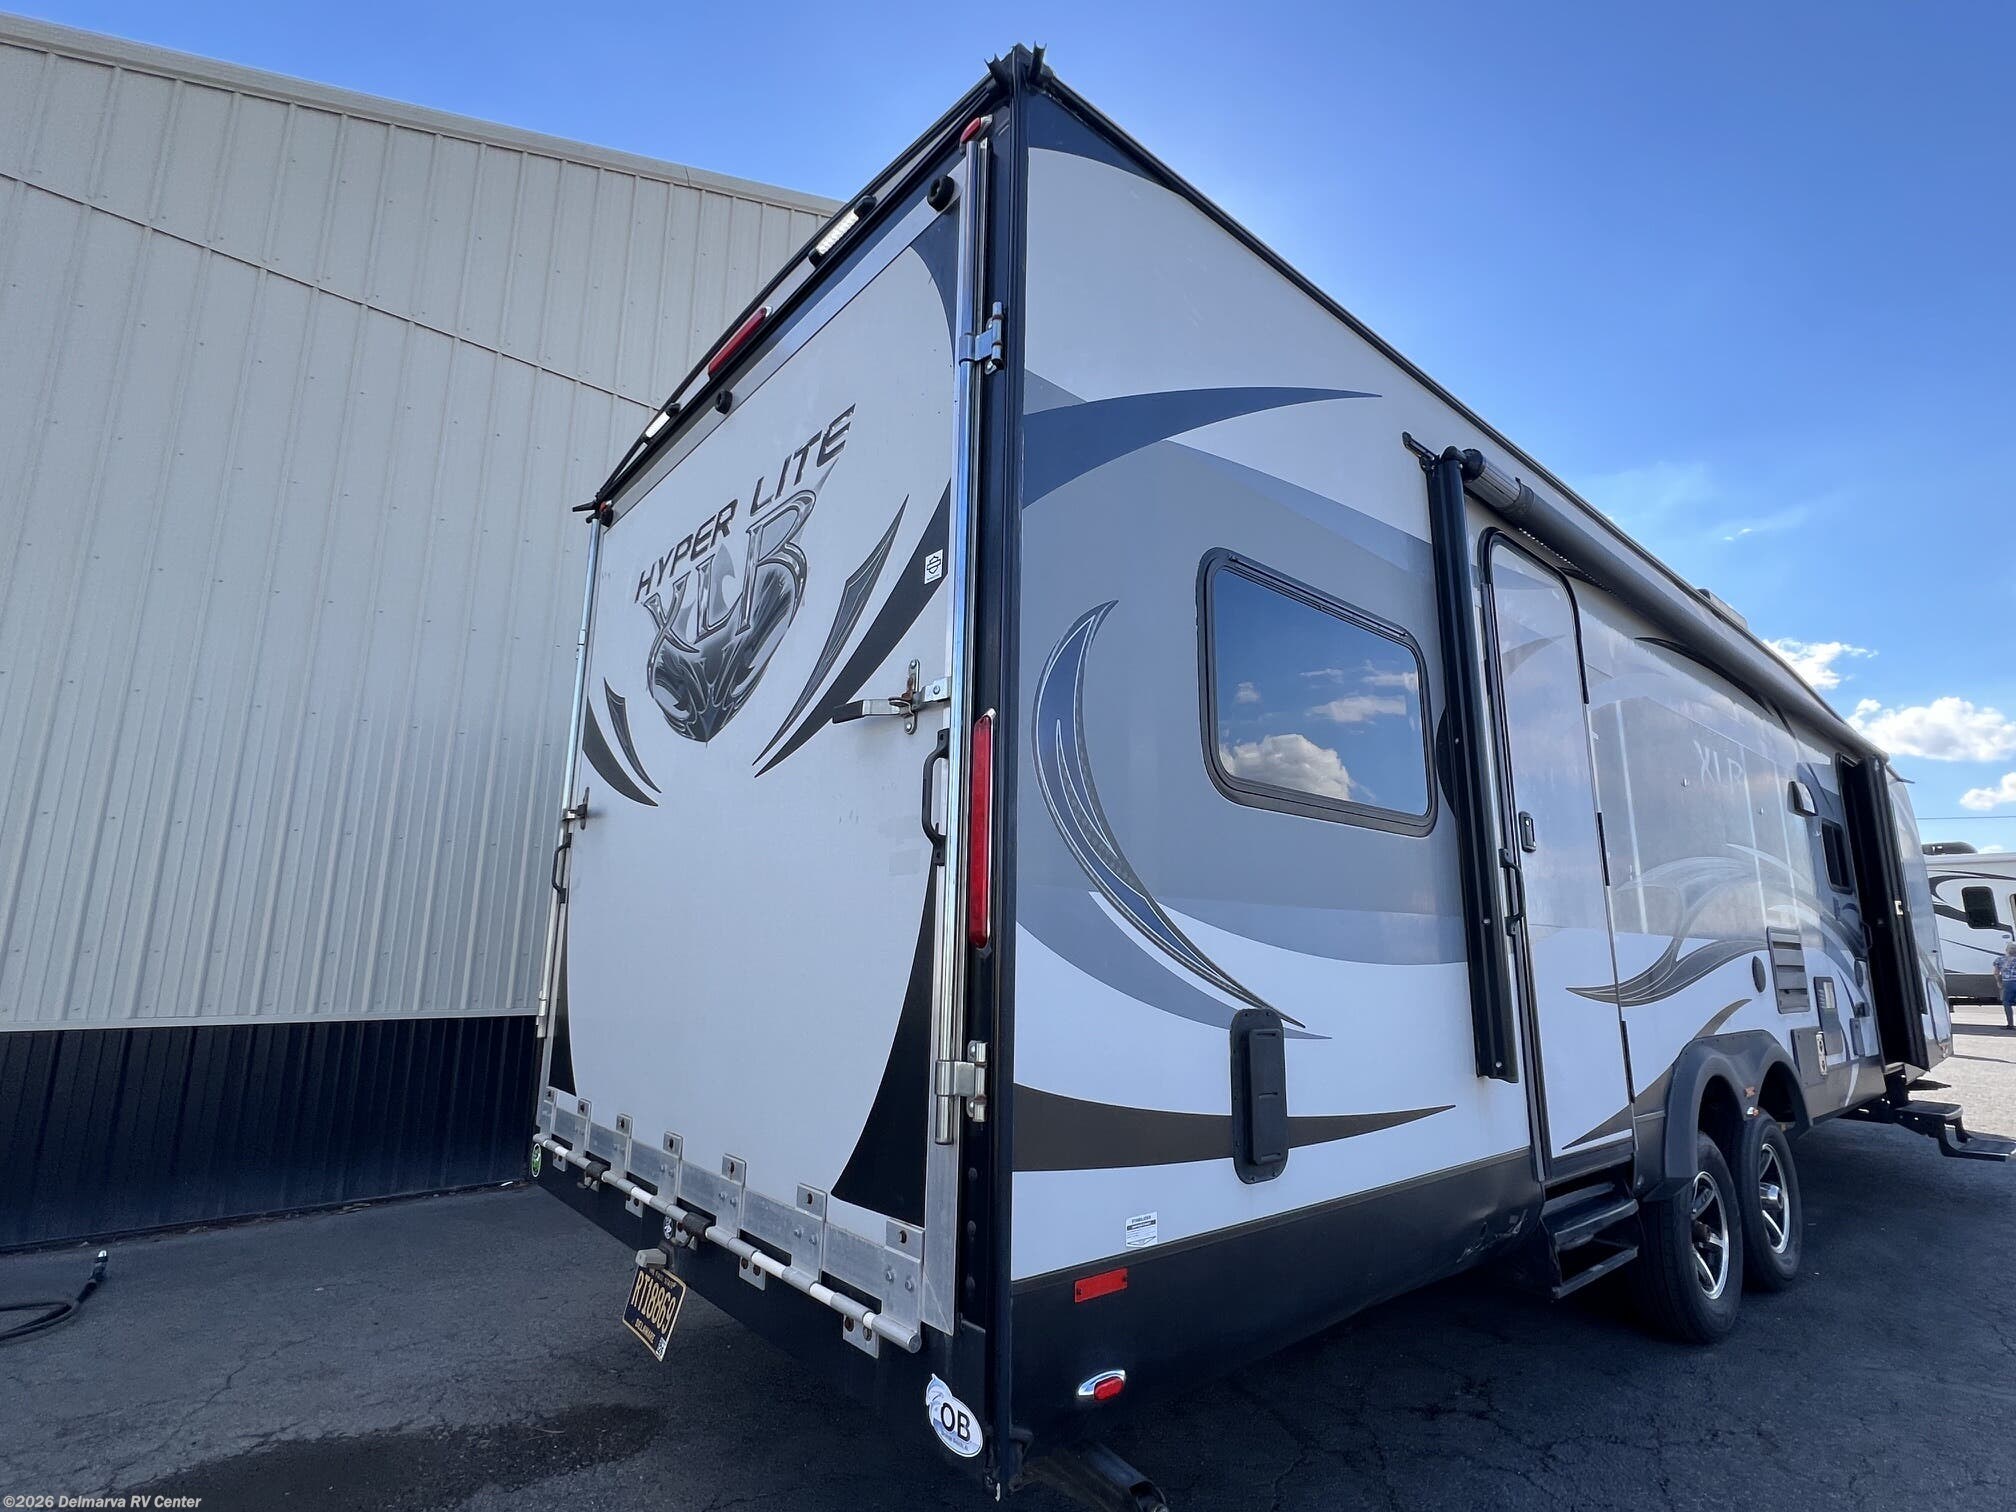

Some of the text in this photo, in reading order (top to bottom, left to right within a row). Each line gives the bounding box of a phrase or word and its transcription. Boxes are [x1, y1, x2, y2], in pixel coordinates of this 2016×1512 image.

[634, 402, 856, 604] HYPER LITE
[630, 1270, 677, 1335] RT18869
[940, 1402, 971, 1442] OB
